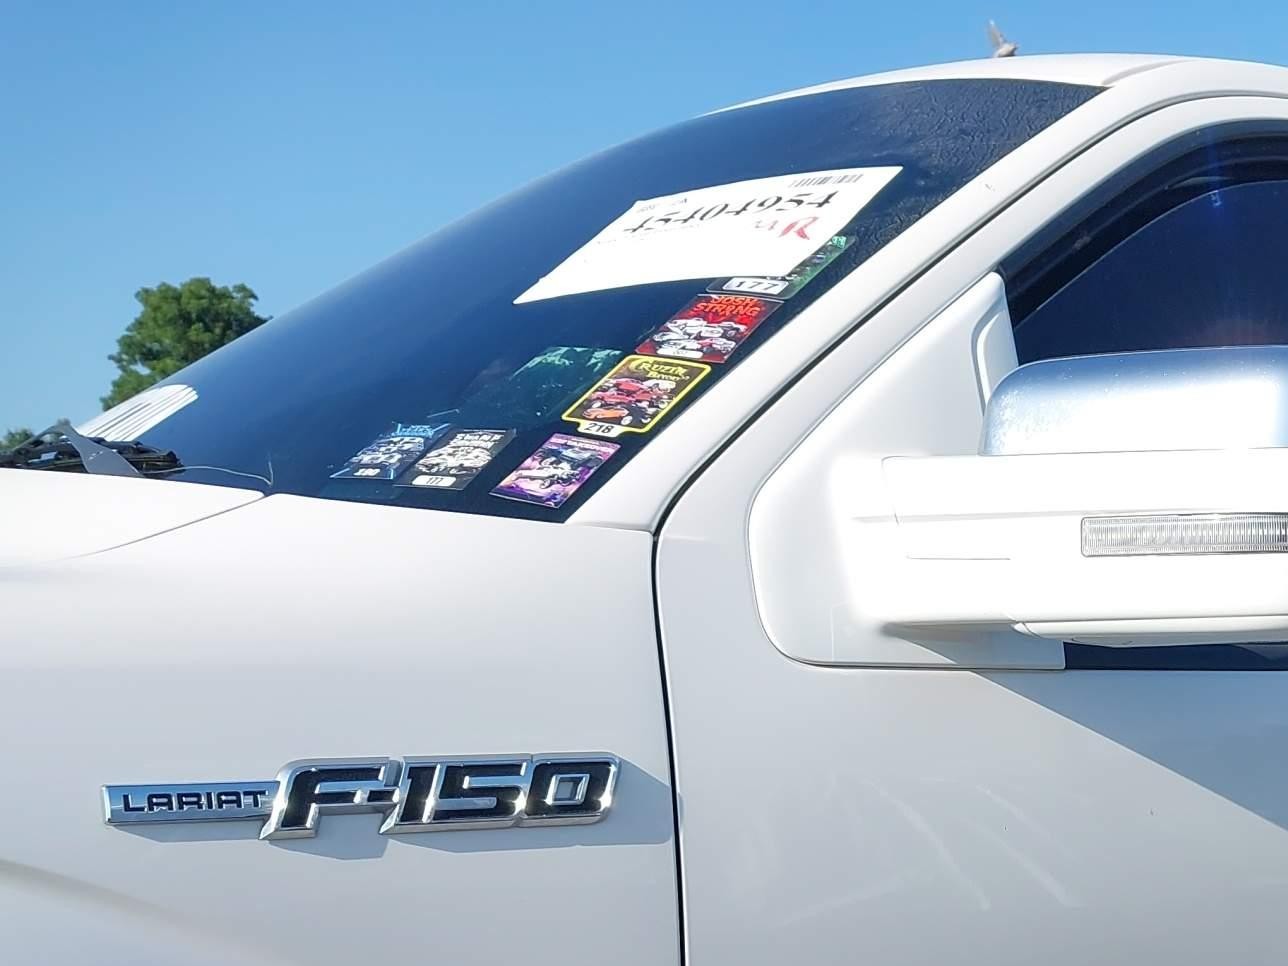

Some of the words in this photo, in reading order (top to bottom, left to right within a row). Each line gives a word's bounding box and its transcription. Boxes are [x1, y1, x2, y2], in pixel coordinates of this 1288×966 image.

[624, 191, 839, 233] 45404954
[735, 280, 779, 291] 177
[583, 422, 615, 434] 218
[122, 789, 268, 813] LARIAT
[259, 752, 620, 840] F-150
